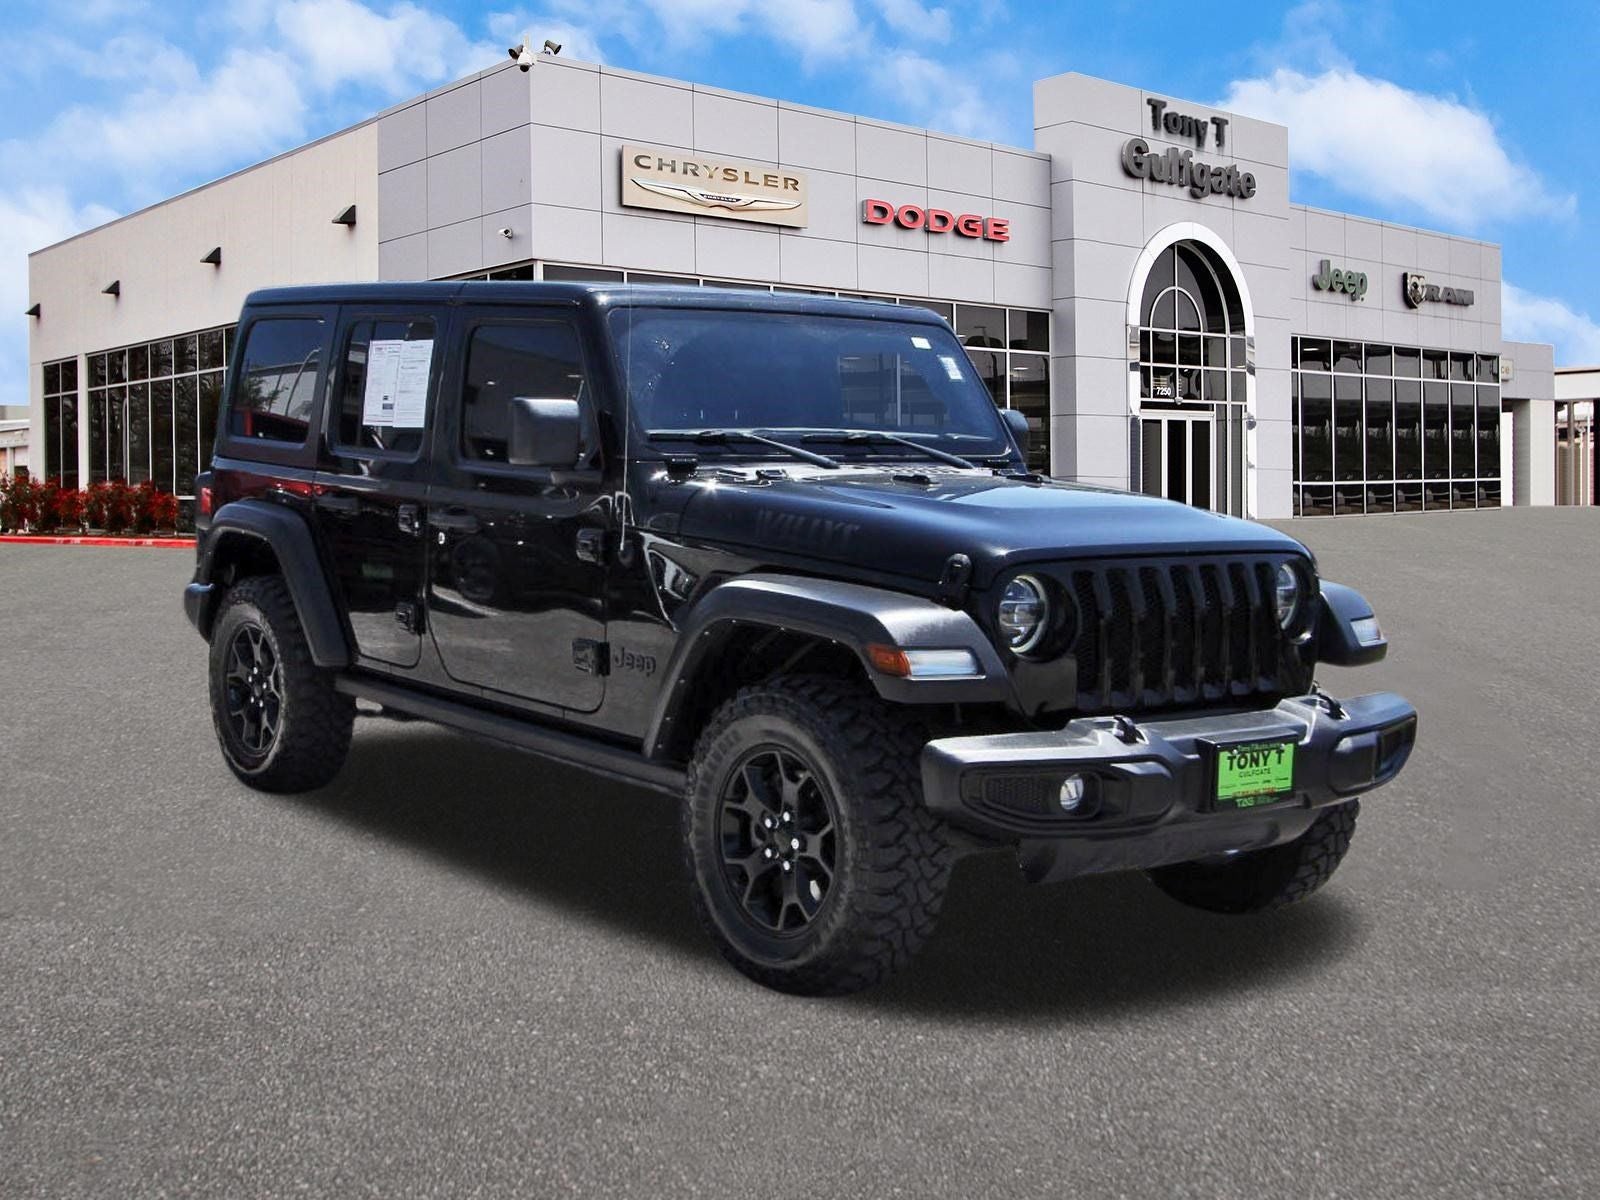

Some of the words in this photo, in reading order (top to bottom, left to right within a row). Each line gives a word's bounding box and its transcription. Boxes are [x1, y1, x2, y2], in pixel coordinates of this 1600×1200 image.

[1146, 98, 1208, 148] Tony
[1210, 116, 1229, 148] T
[633, 154, 800, 192] CHRYSLER
[1121, 138, 1257, 199] Gulfgate
[862, 199, 1010, 242] DODGE
[1312, 259, 1368, 302] Jeep
[1425, 283, 1475, 306] RAM
[1156, 386, 1172, 396] 7250
[614, 646, 657, 678] Jeep
[1227, 750, 1271, 771] TONY
[1275, 748, 1285, 766] T
